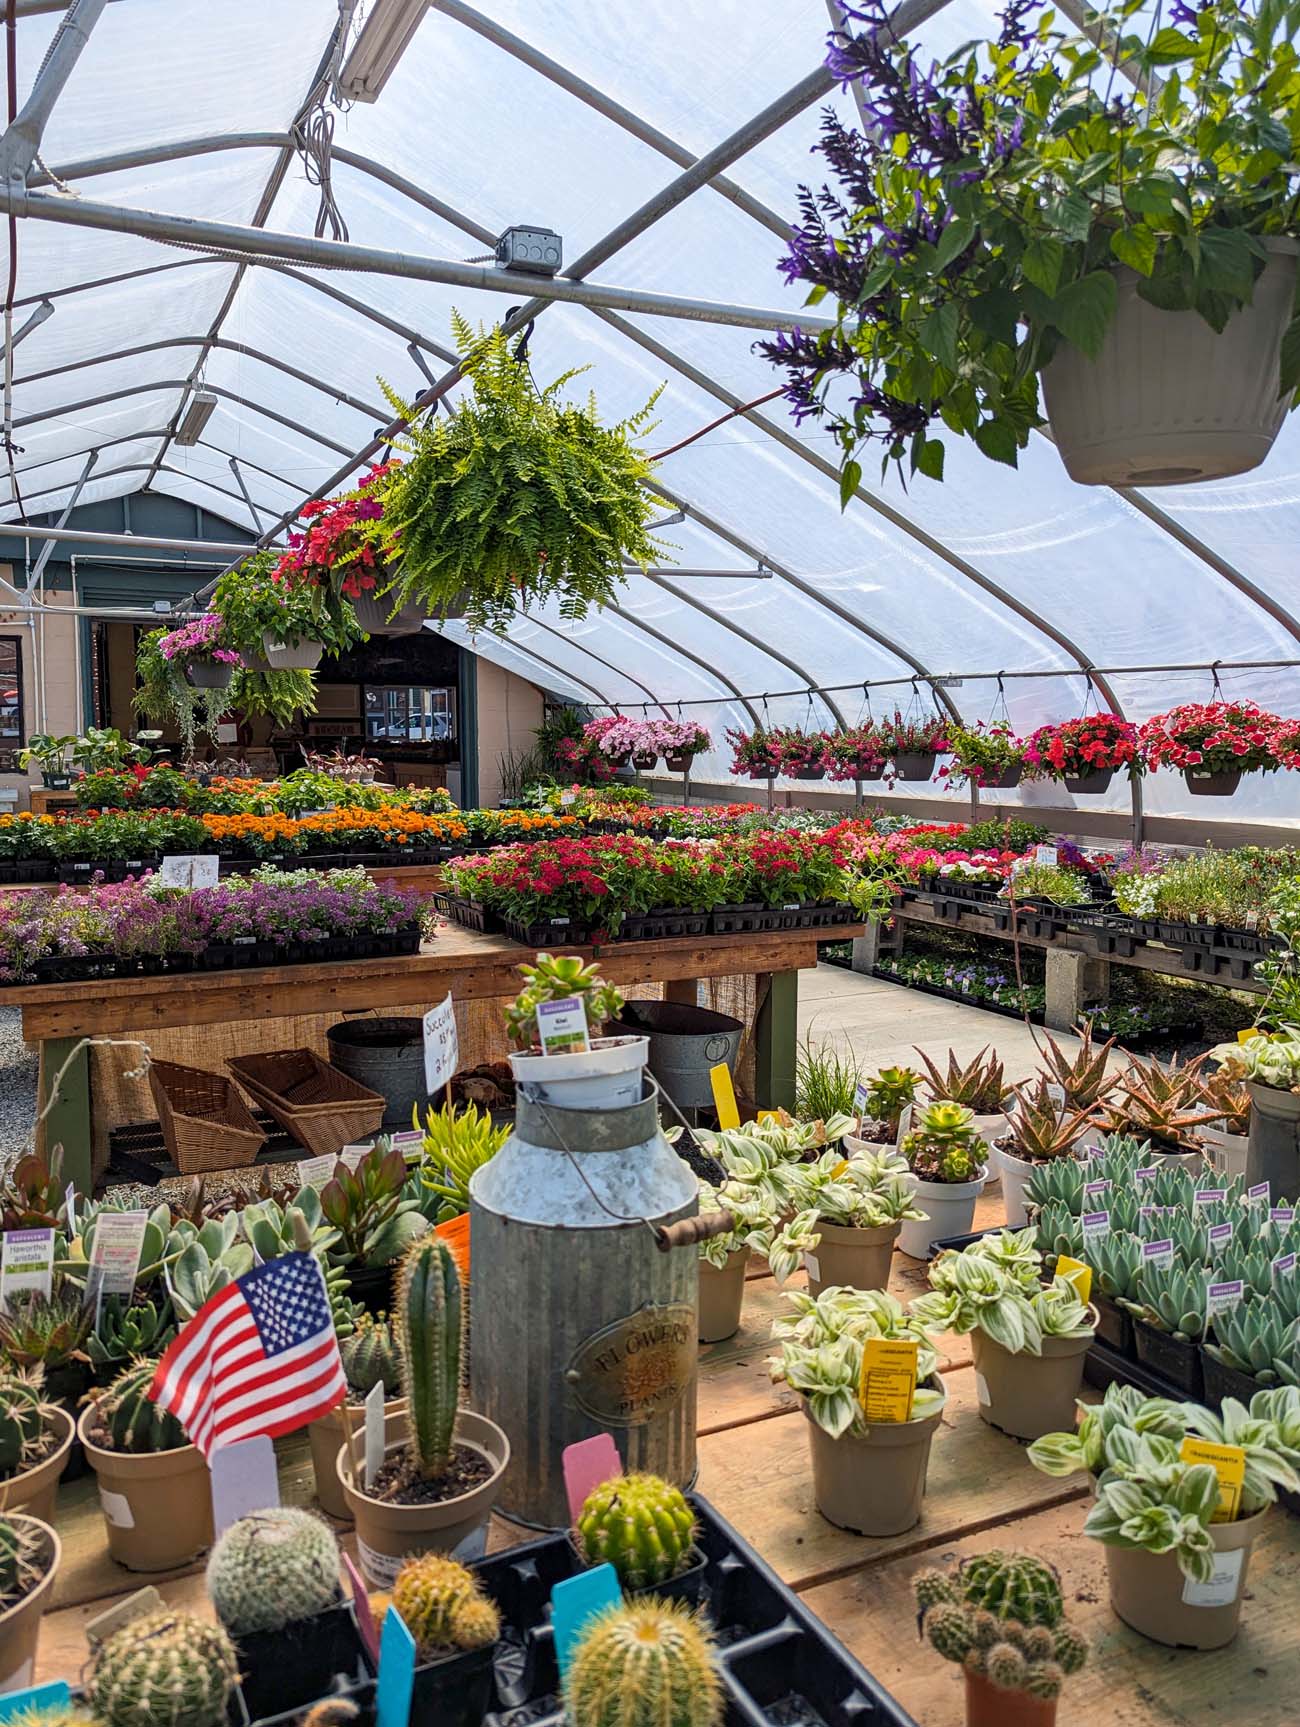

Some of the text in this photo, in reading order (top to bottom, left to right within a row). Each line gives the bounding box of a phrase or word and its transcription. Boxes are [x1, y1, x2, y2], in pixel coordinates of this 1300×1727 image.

[9, 1243, 48, 1254] Haworthia
[594, 1323, 690, 1374] FLOWERS
[616, 1384, 678, 1415] PLANTS
